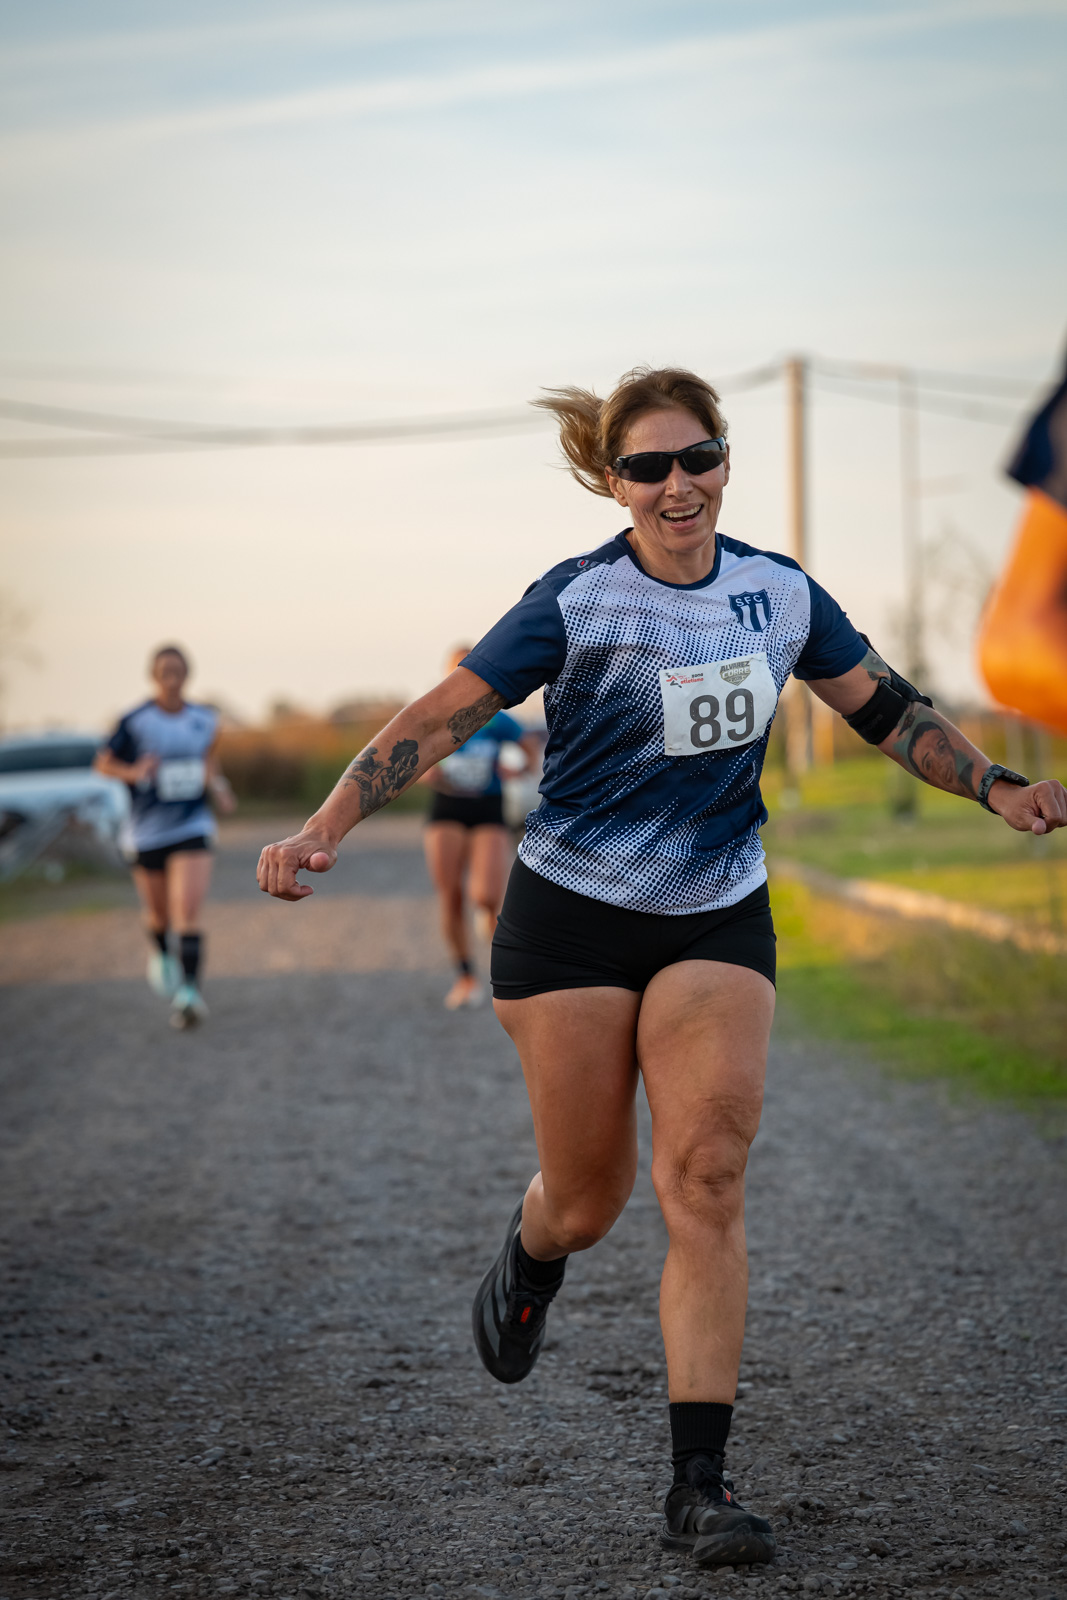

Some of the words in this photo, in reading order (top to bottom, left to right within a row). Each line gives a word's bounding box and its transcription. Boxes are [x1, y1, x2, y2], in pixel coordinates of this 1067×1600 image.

[735, 594, 763, 607] SFC
[720, 660, 750, 672] ALVAREZ
[722, 667, 751, 679] CORRE
[689, 688, 755, 749] 89
